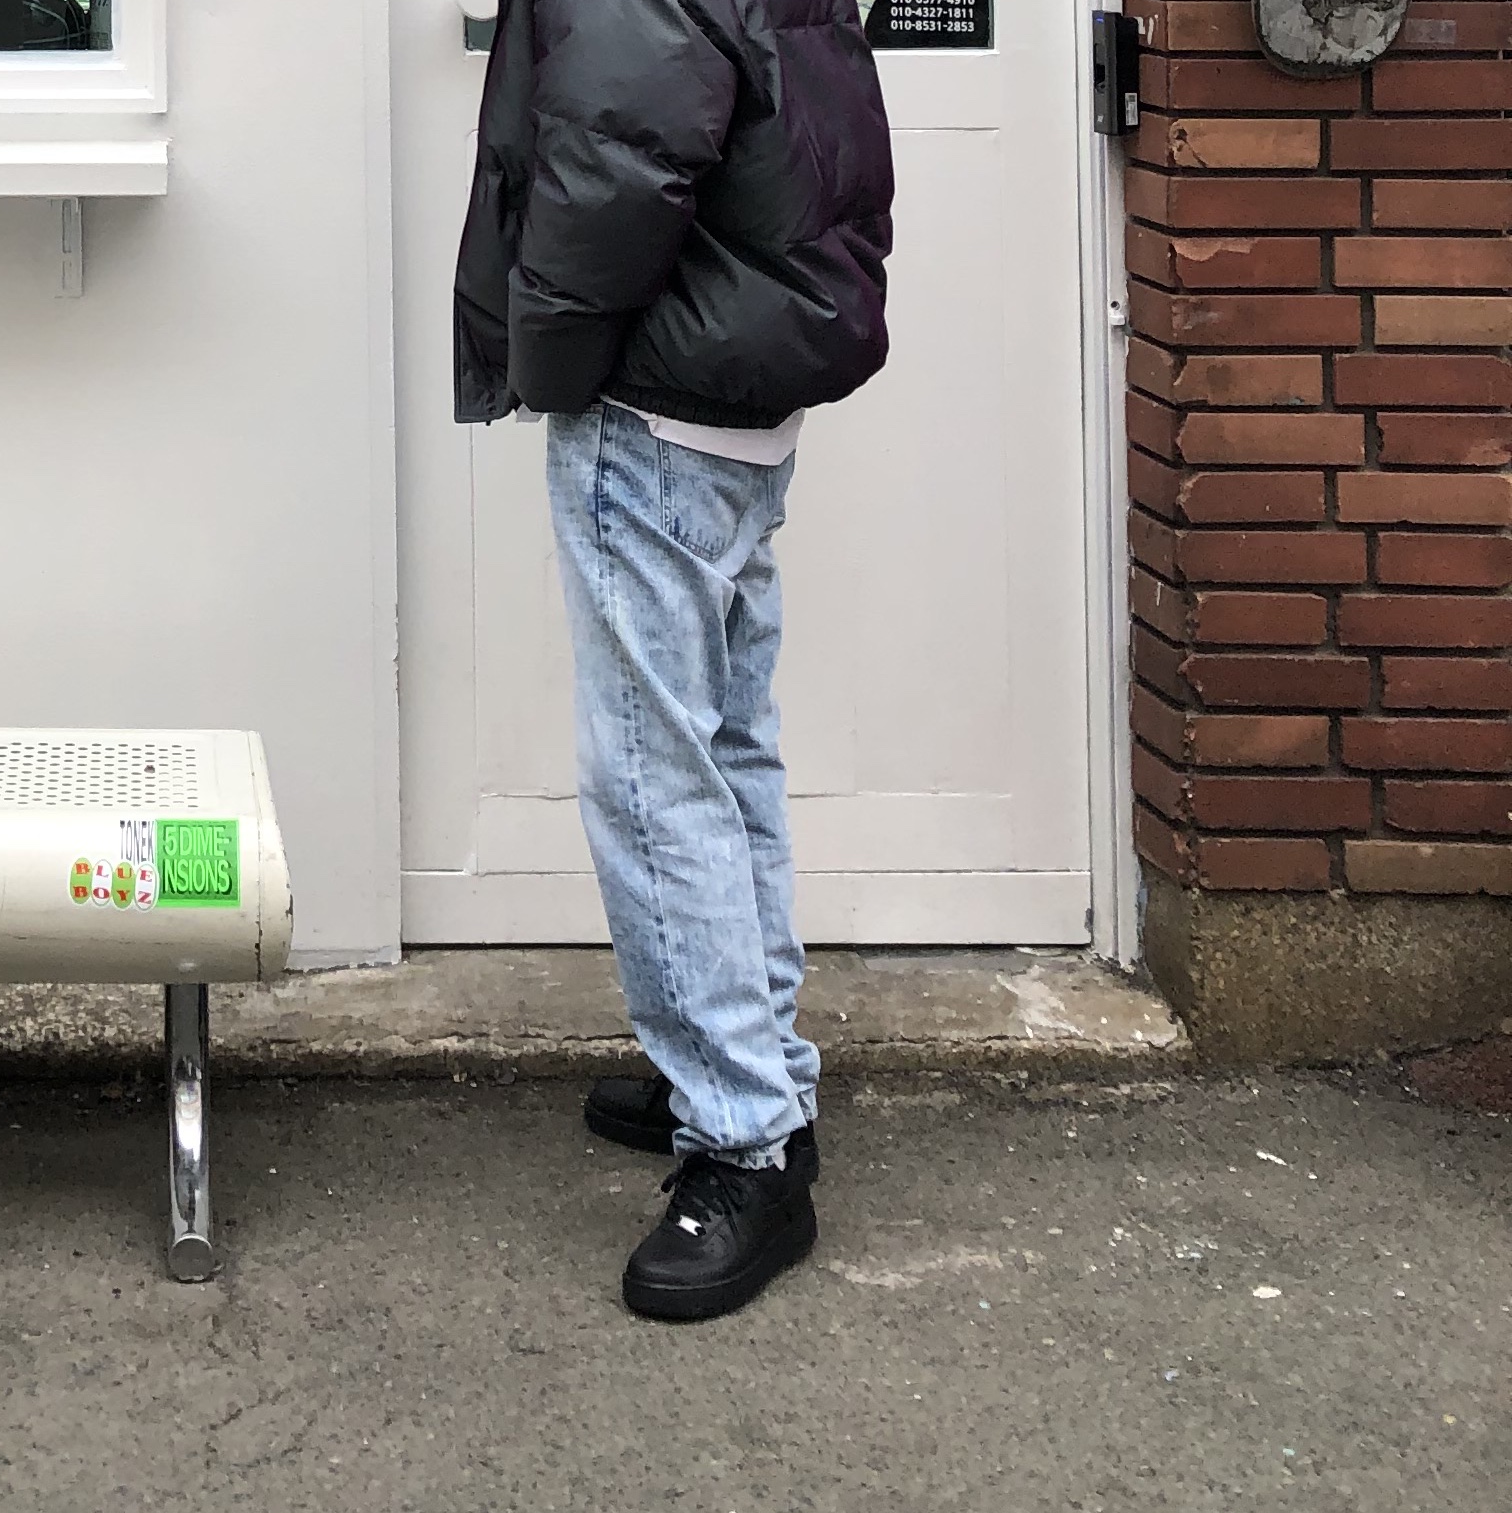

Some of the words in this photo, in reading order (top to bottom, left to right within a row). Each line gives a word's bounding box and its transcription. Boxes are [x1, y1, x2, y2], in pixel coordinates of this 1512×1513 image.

[890, 6, 974, 19] 010-4327-1811
[890, 20, 975, 32] 010-8531-2853
[163, 858, 232, 895] NSIONS
